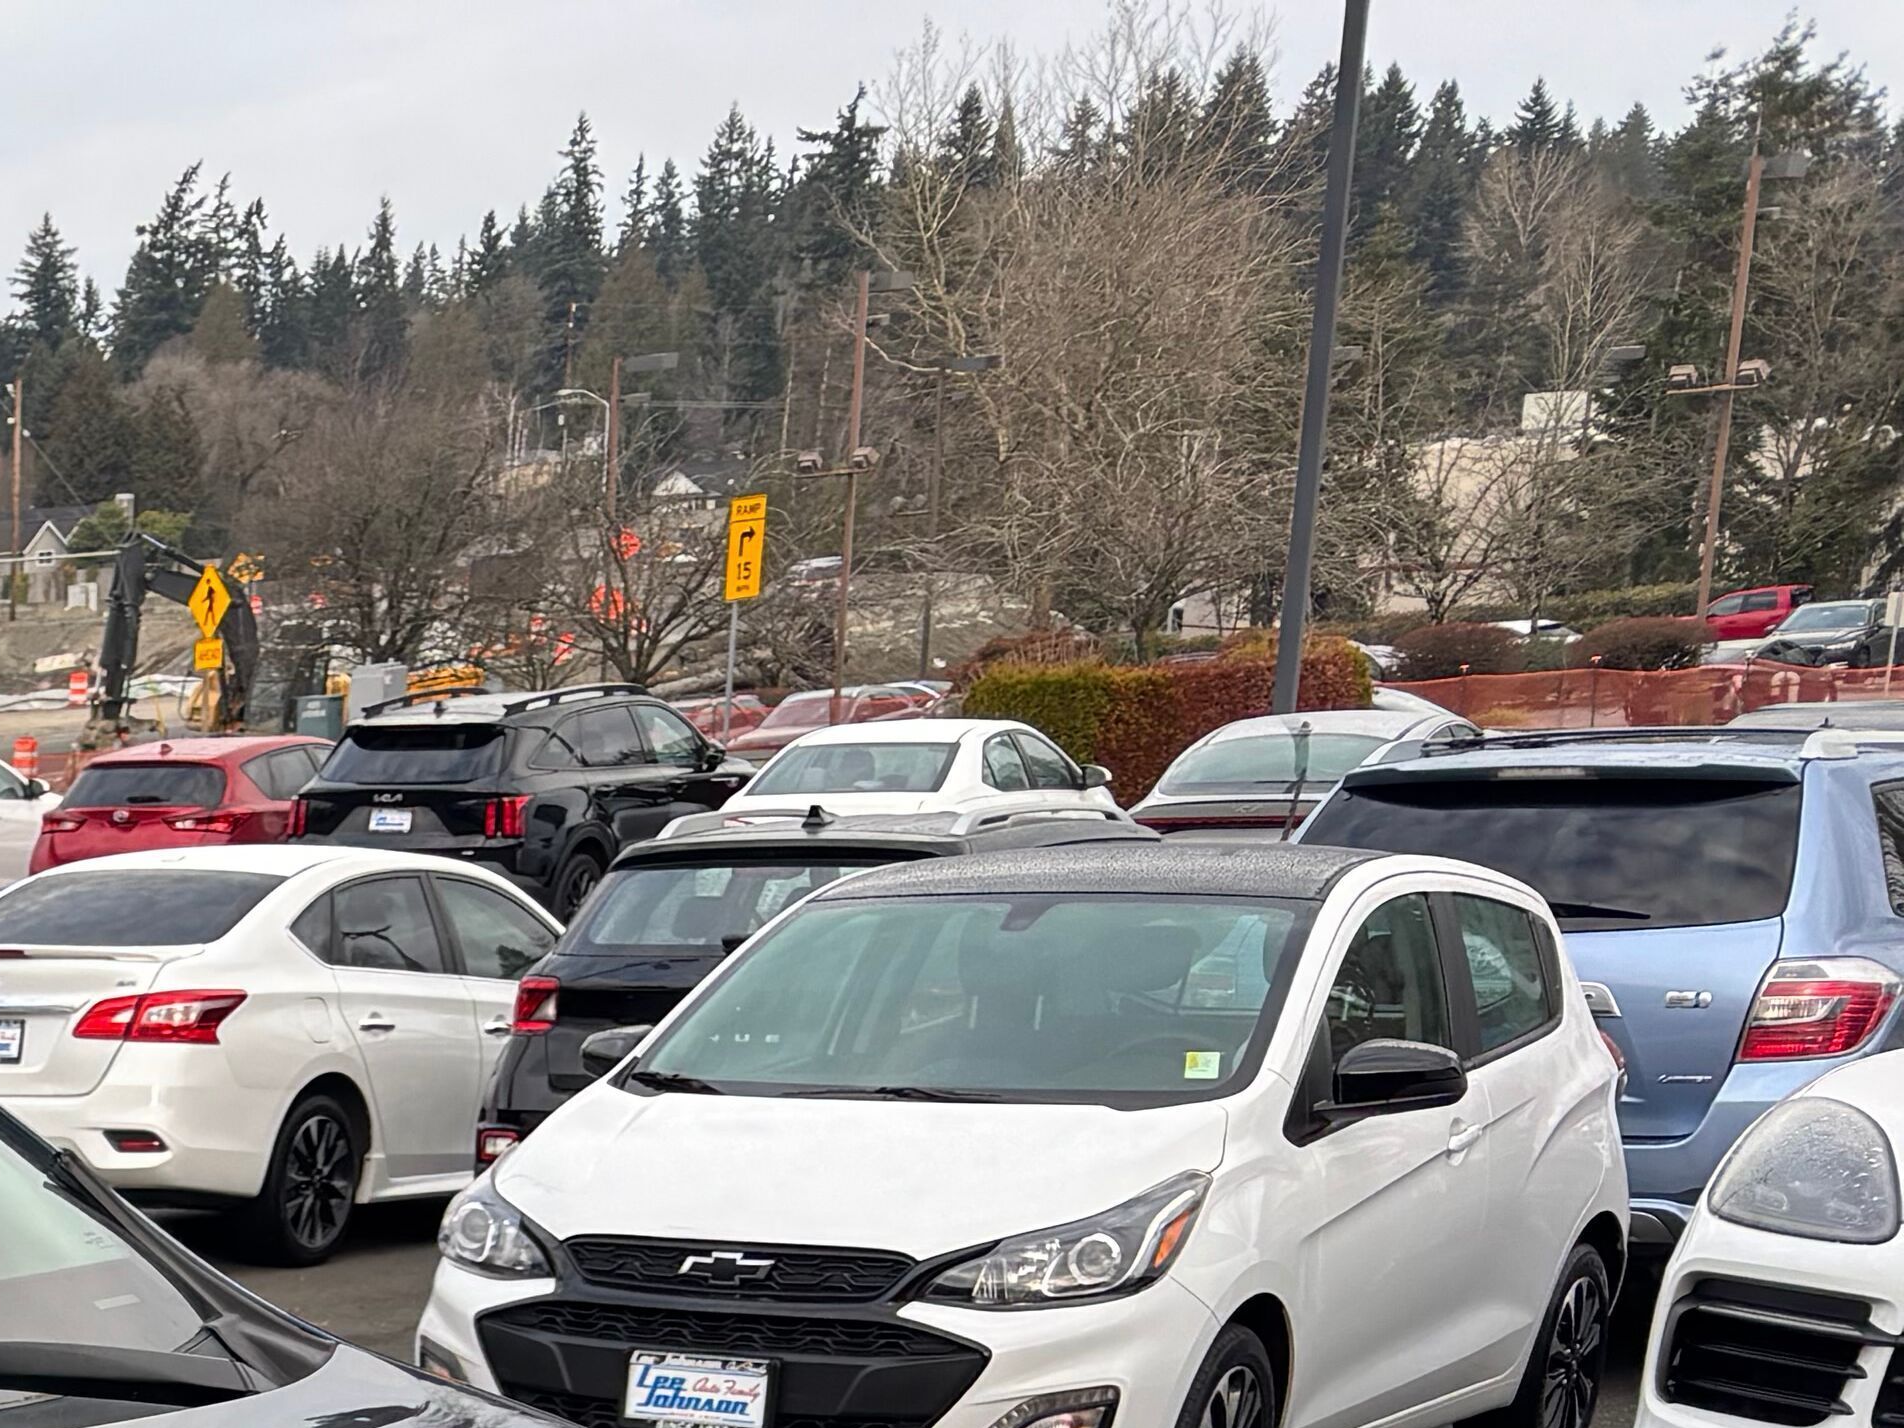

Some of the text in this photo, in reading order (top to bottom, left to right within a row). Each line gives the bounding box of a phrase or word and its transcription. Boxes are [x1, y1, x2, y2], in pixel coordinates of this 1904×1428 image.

[735, 502, 762, 518] RAMP
[736, 561, 752, 581] 15
[637, 1364, 687, 1391] Lee
[693, 1377, 721, 1394] Auto
[636, 1387, 750, 1416] Johnson
